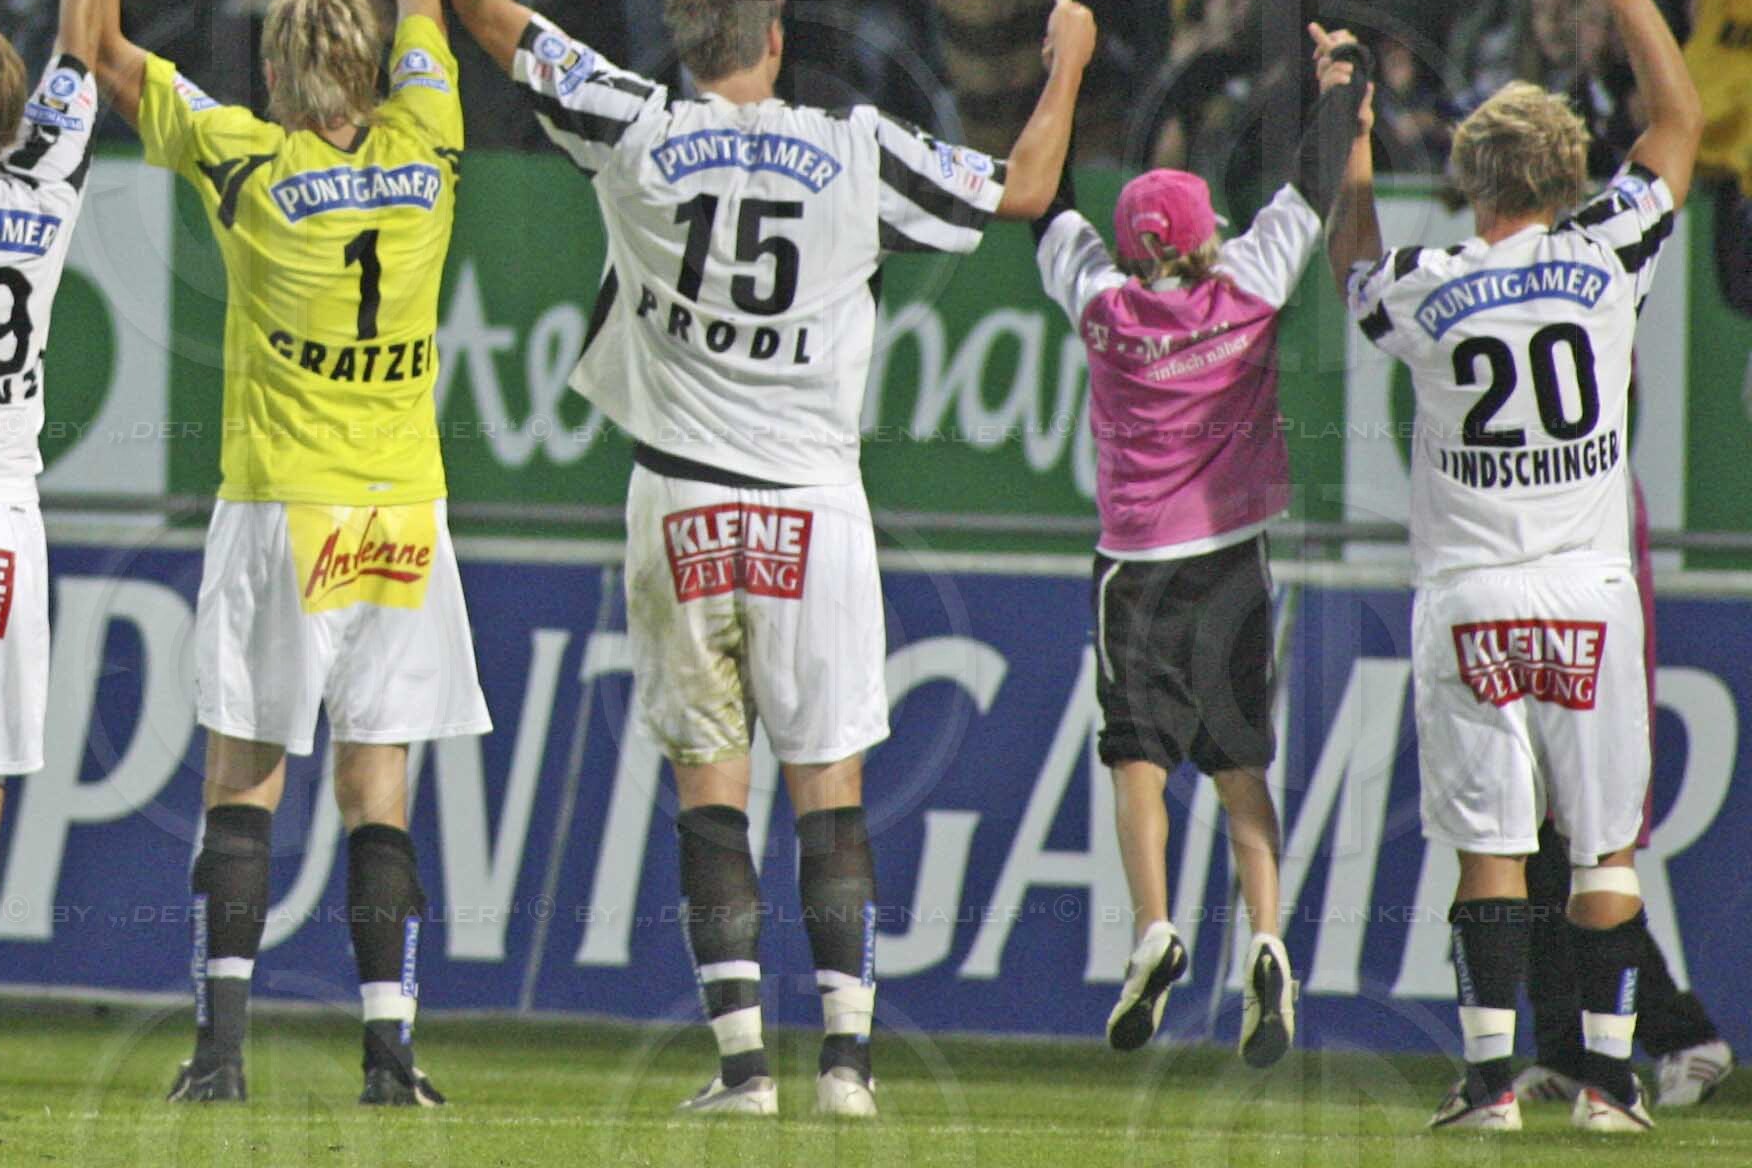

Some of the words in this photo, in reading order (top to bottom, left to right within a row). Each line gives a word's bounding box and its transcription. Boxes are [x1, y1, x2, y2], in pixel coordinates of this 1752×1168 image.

[278, 170, 440, 214] PUNTGAMER
[344, 229, 381, 340] 1
[672, 193, 804, 316] 15
[1419, 266, 1603, 331] PUNTIGAMER
[1452, 323, 1600, 447] 20
[1461, 627, 1598, 668] KLEINE
